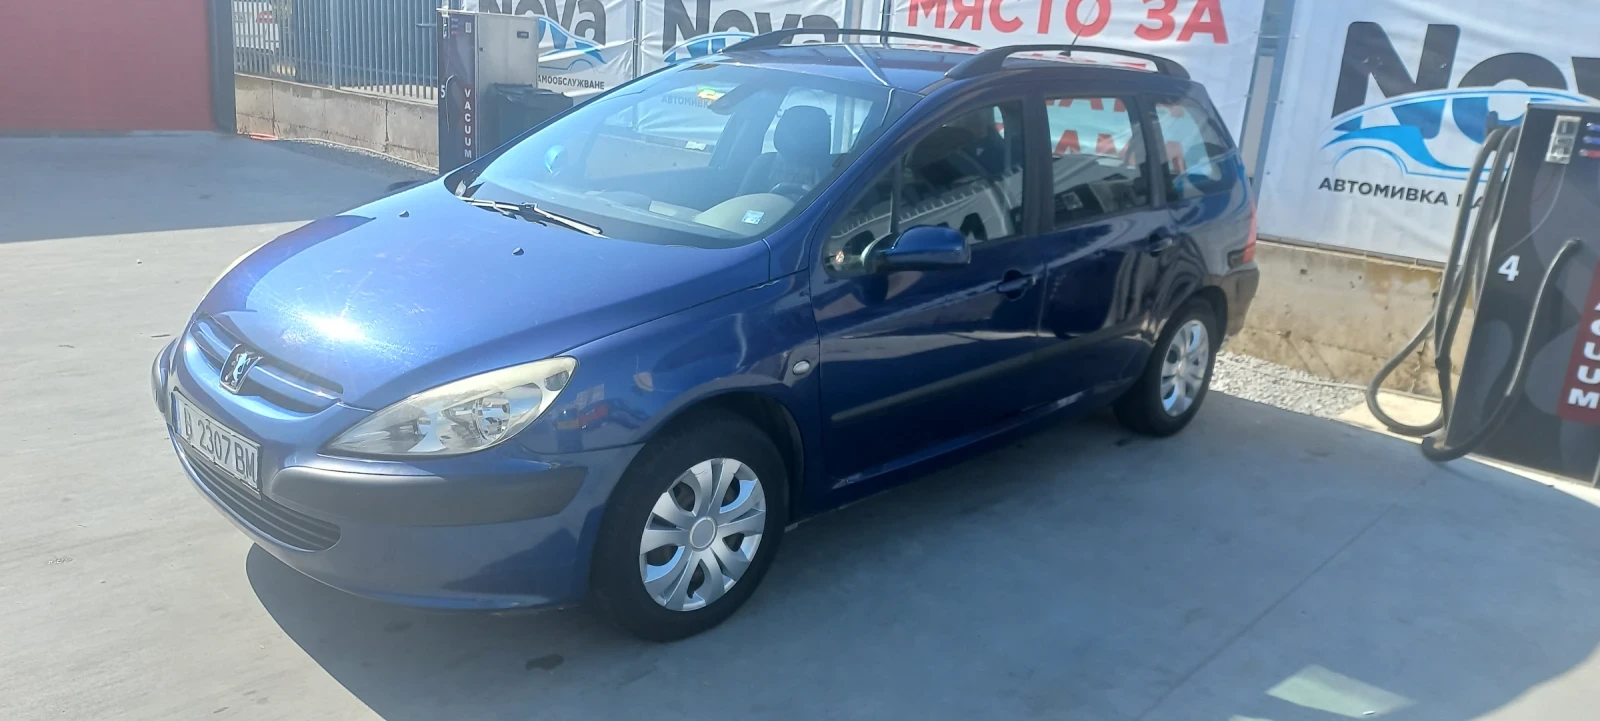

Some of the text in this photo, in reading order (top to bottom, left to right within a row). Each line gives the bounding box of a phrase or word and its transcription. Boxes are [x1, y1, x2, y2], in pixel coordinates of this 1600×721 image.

[1133, 0, 1229, 45] ЗА
[440, 85, 446, 99] 5
[1331, 21, 1600, 142] No
[464, 88, 472, 159] VACUUM
[1318, 177, 1449, 206] АВТОМИВКА
[1498, 254, 1520, 282] 4
[197, 418, 231, 465] 2307
[234, 441, 257, 483] BM
